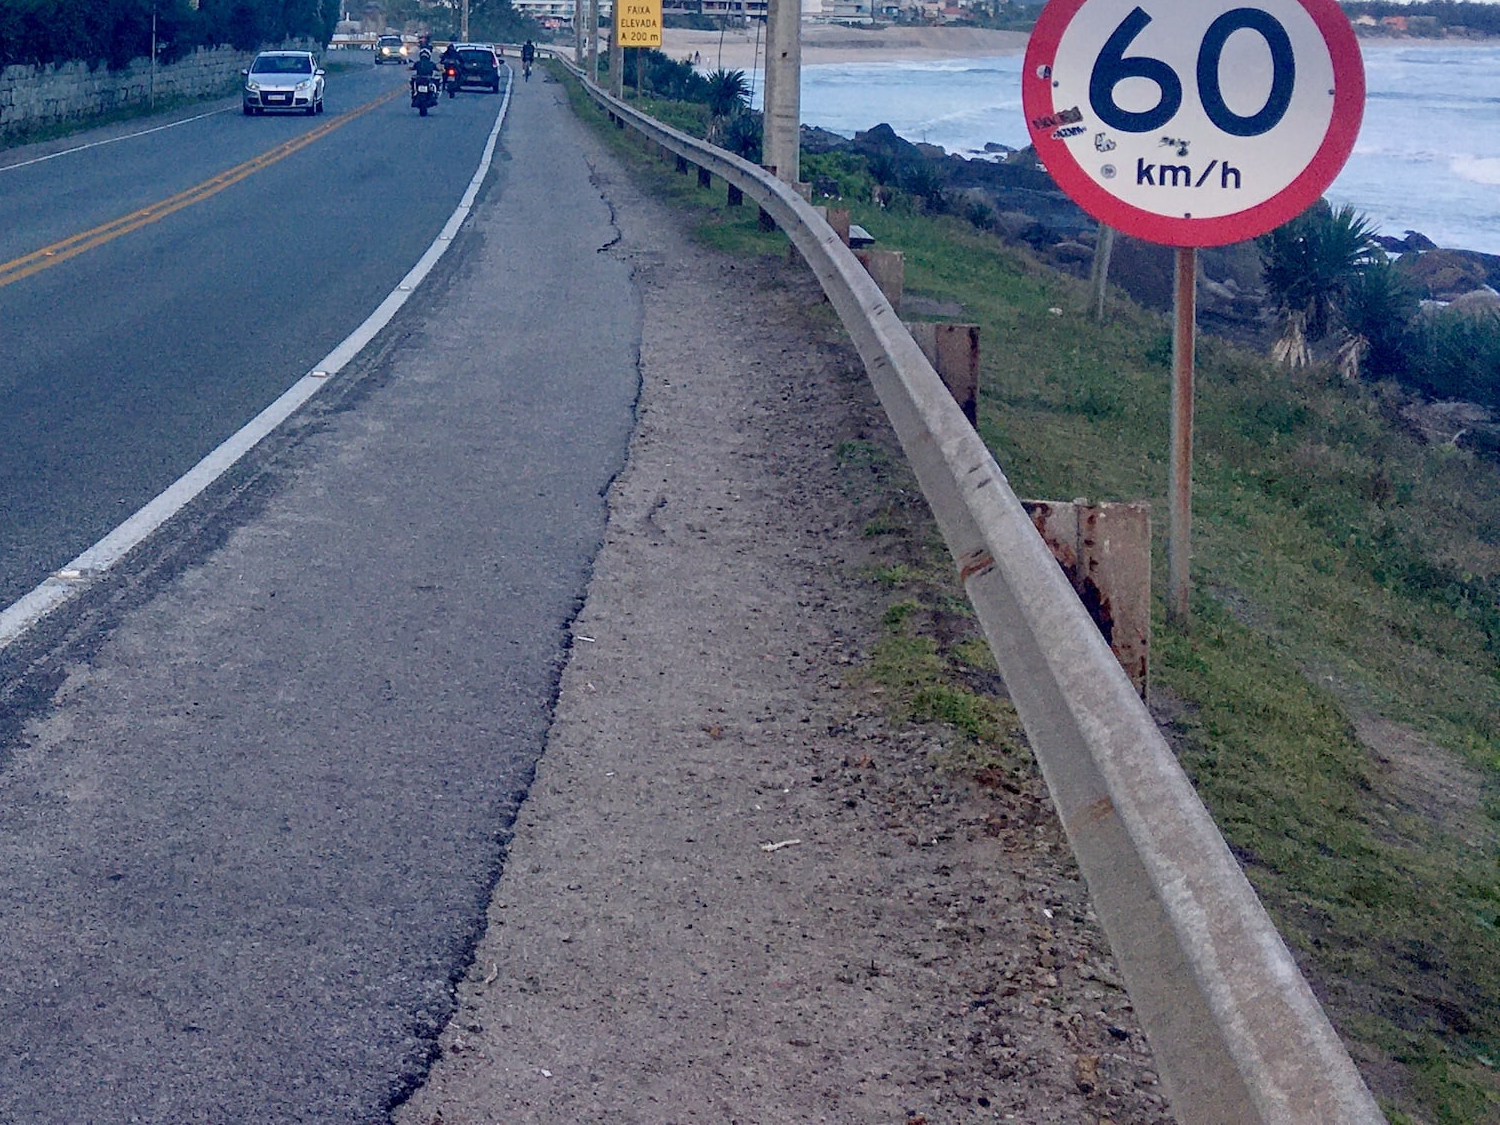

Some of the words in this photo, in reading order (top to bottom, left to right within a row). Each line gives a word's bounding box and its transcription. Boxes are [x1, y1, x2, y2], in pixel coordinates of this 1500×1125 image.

[627, 5, 650, 14] FAIXA
[621, 19, 657, 28] ELEVADA
[620, 32, 627, 40] A
[631, 31, 647, 41] 200
[650, 33, 658, 41] m
[1089, 6, 1296, 137] 60
[1136, 158, 1242, 189] km/h
